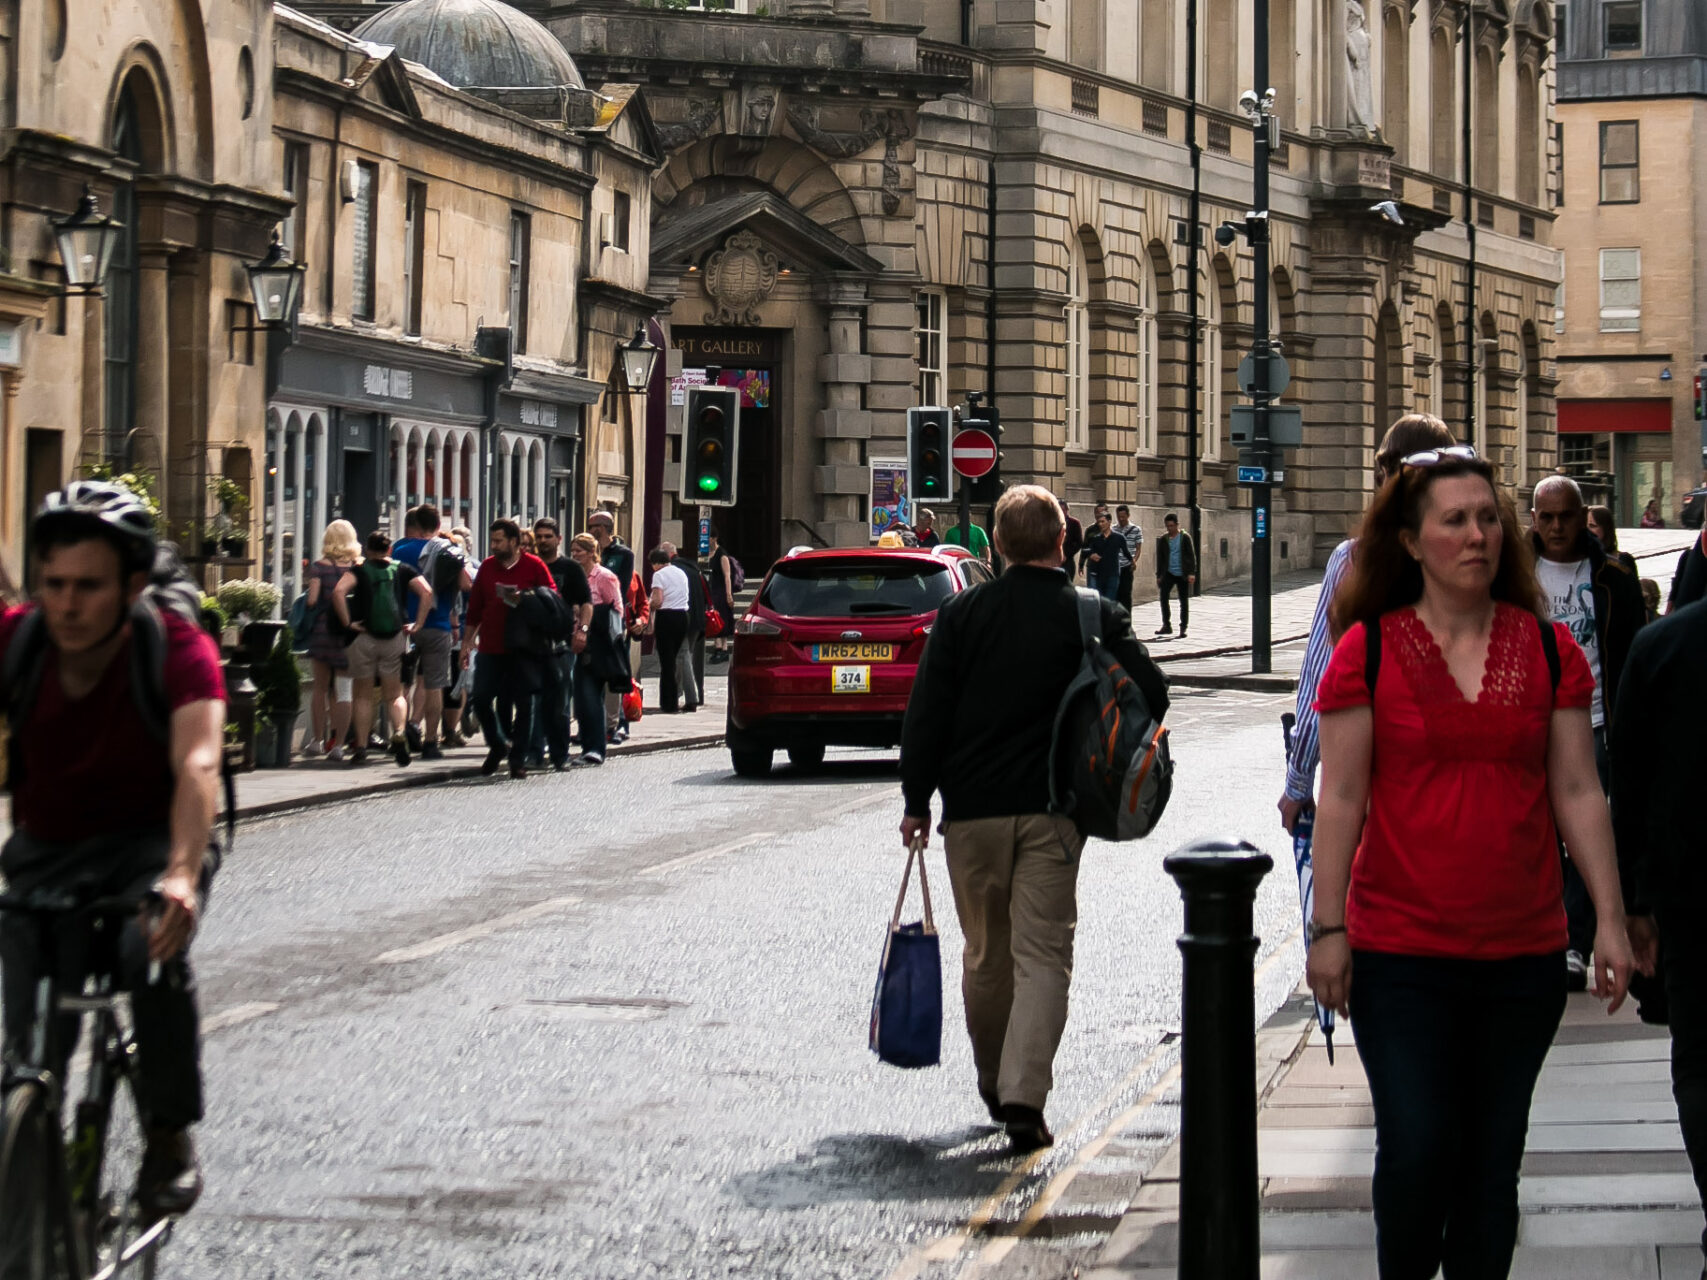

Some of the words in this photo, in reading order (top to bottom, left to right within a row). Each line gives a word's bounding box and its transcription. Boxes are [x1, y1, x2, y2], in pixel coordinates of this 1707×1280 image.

[701, 340, 763, 355] GALLERY
[822, 644, 858, 658] WR62
[840, 673, 861, 683] 374
